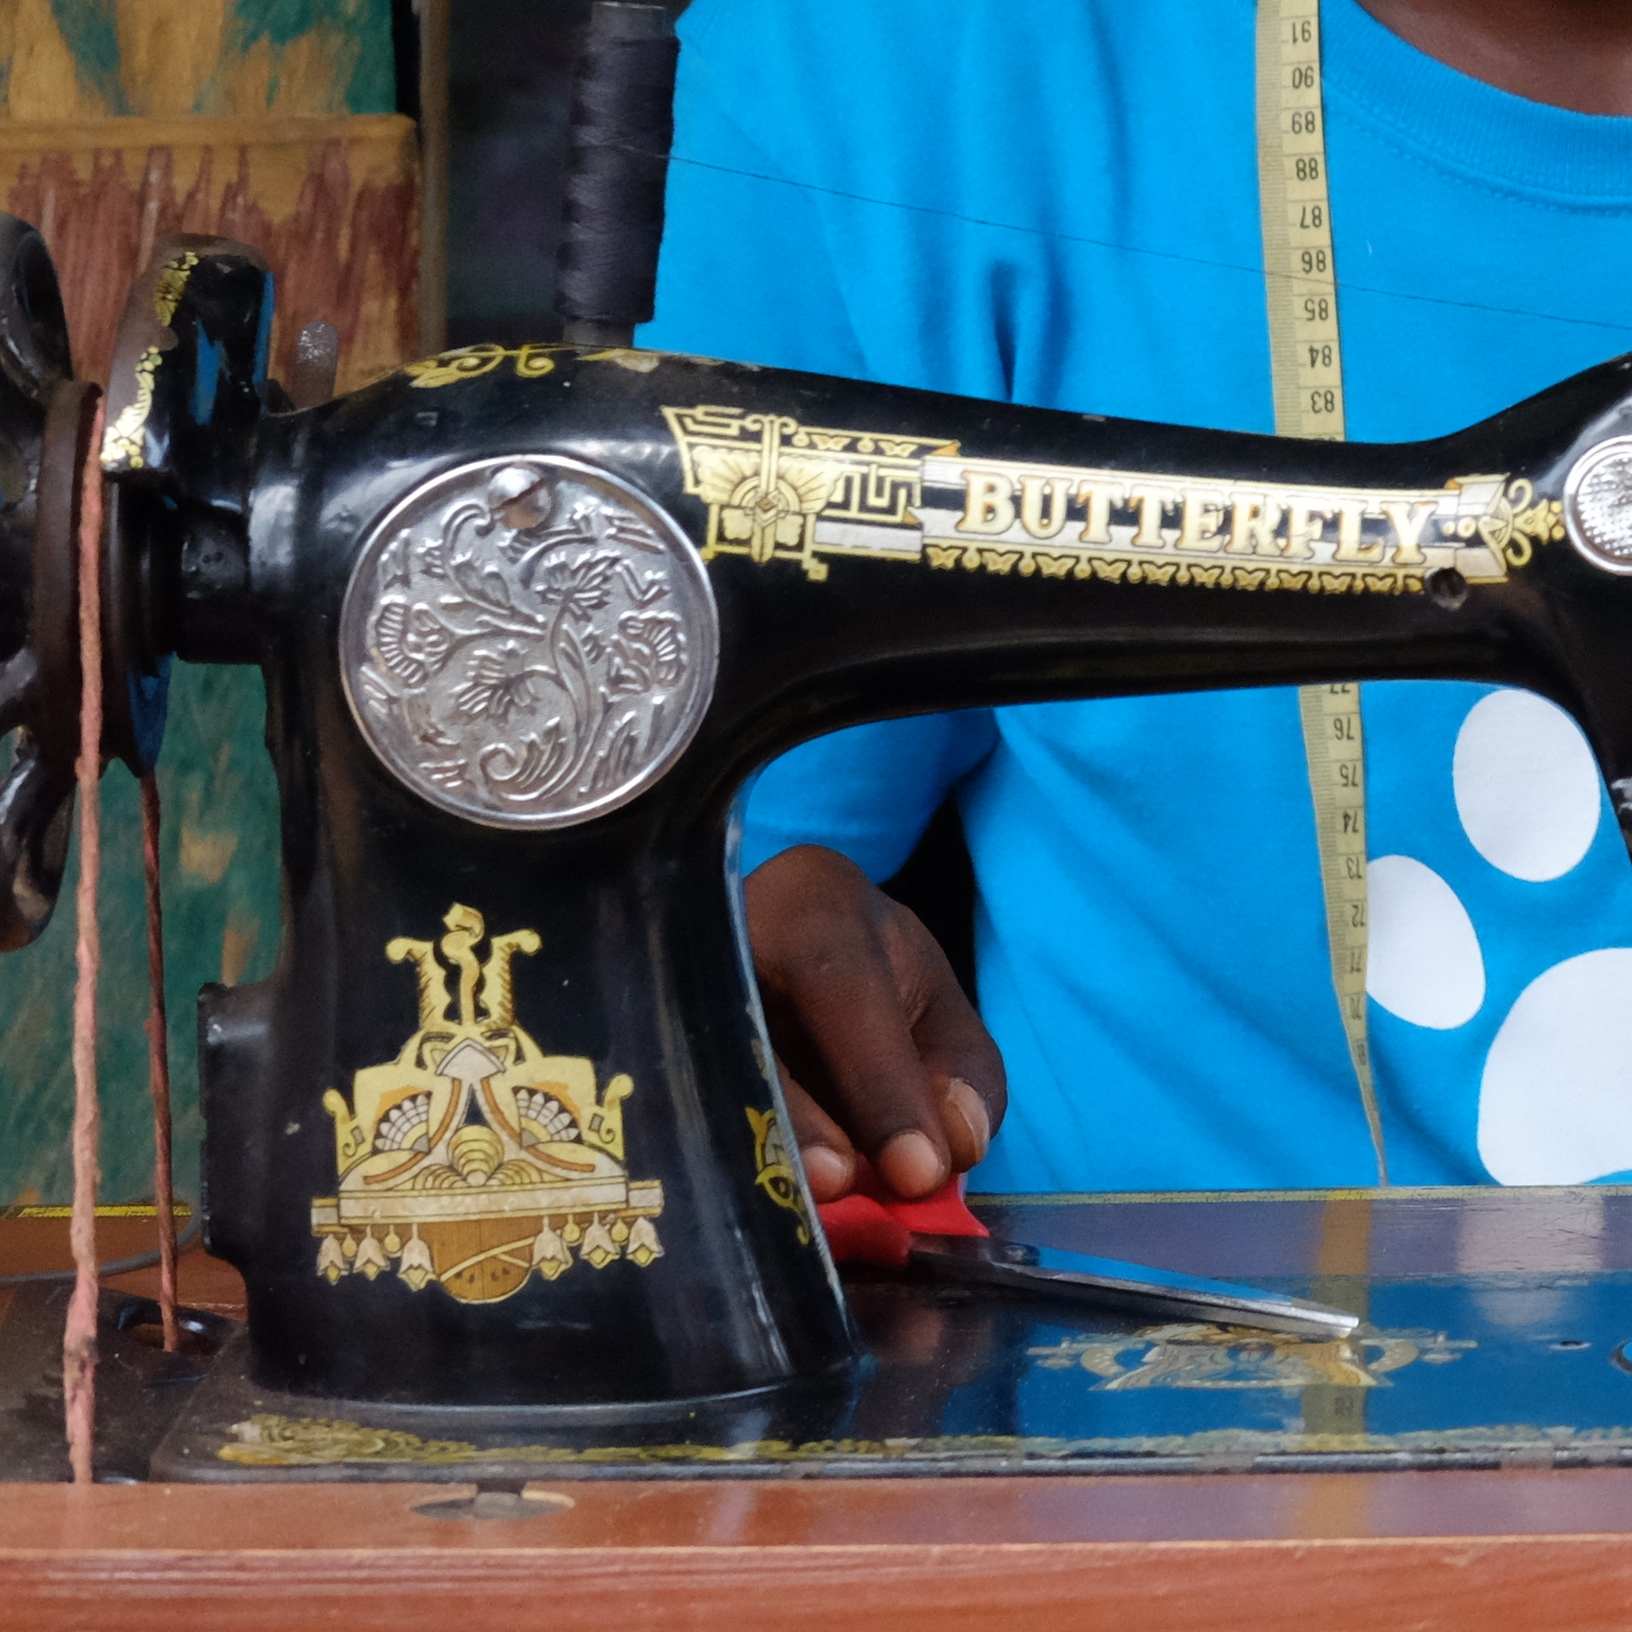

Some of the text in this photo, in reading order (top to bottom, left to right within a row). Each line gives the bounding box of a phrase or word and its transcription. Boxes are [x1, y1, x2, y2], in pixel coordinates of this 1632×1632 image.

[1290, 20, 1313, 44] 91
[1292, 65, 1315, 89] 90
[1291, 111, 1316, 135] 89
[1295, 157, 1319, 182] 88
[1299, 204, 1323, 229] 87
[1301, 249, 1327, 274] 86
[1304, 297, 1329, 321] 85
[1308, 344, 1333, 369] 84
[1310, 389, 1335, 414] 83
[956, 469, 1438, 567] BUTTERFLY
[1333, 716, 1355, 741] 76
[1338, 762, 1359, 787] 75
[1342, 809, 1360, 834] 74
[1346, 855, 1363, 880] 73
[1350, 903, 1367, 928] 72
[1348, 949, 1364, 974] 71
